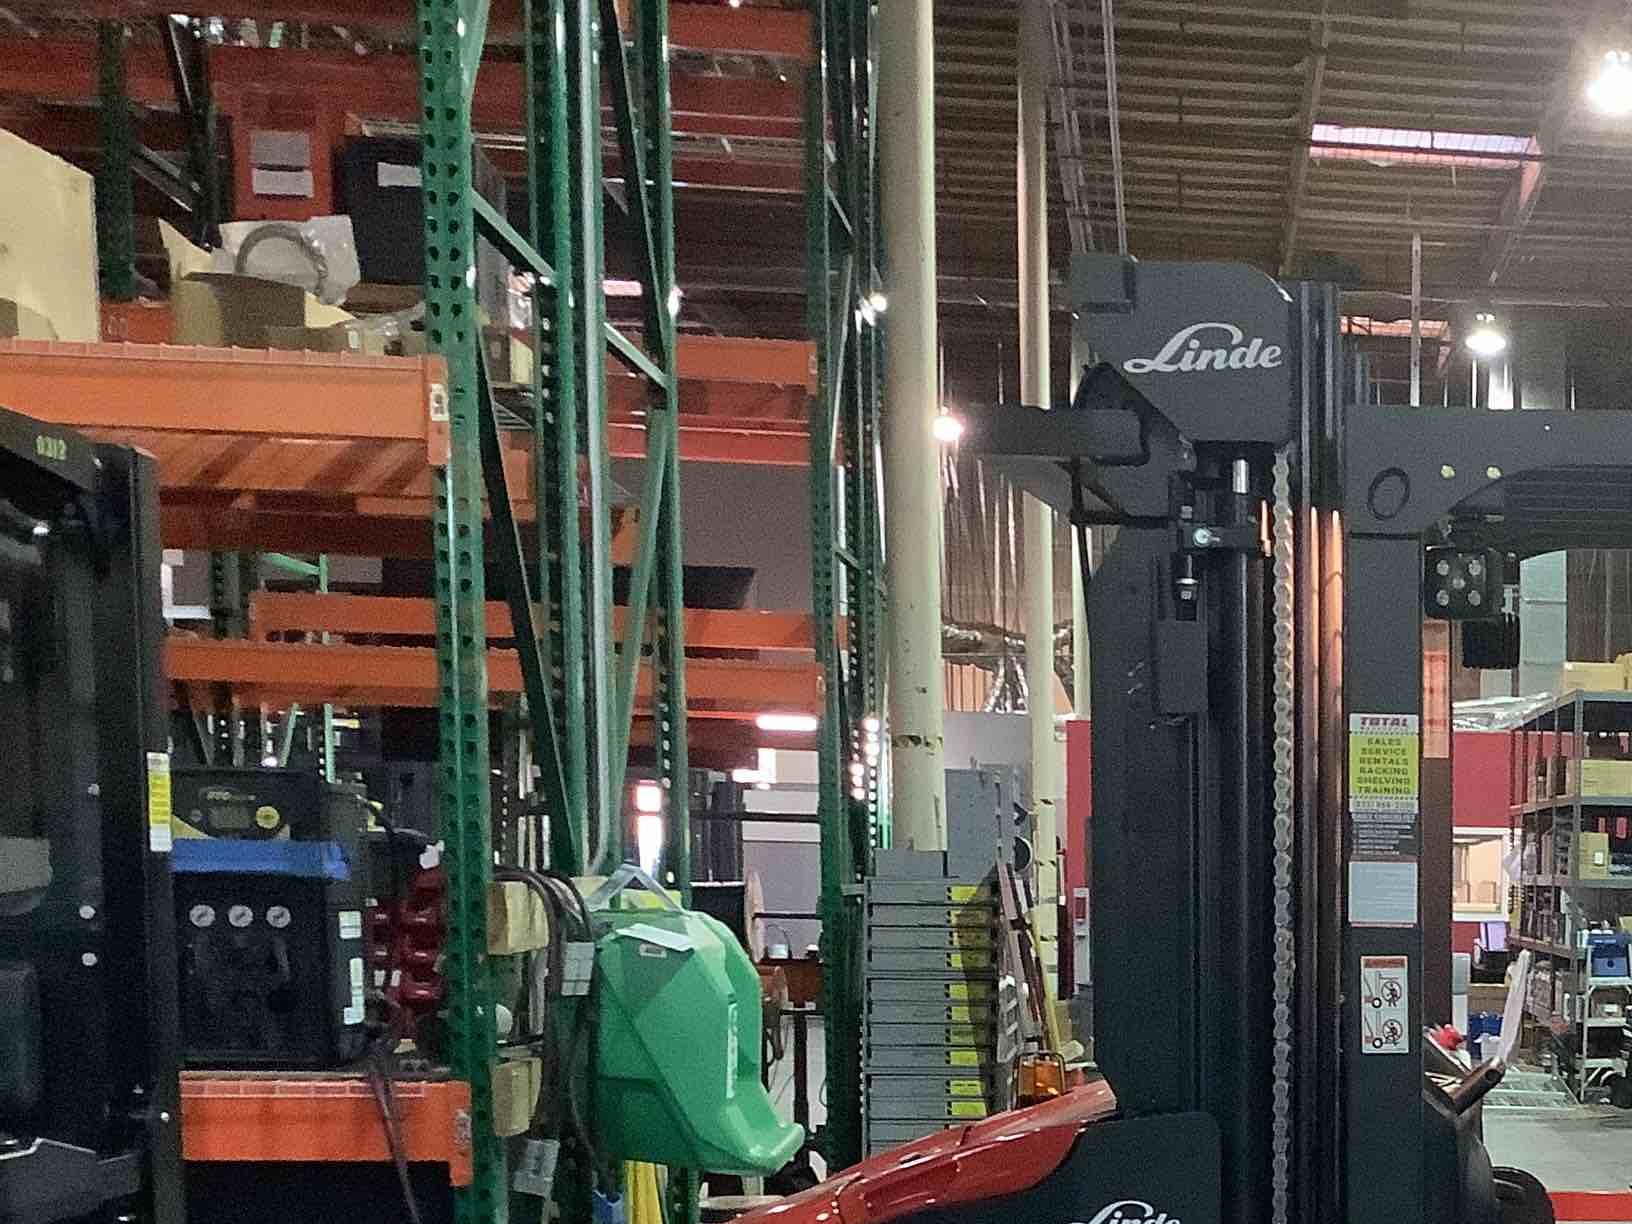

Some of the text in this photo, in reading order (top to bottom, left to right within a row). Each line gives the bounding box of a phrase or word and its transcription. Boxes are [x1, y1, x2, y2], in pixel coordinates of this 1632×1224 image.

[1123, 322, 1283, 374] Linde
[1361, 717, 1408, 727] TOTAL
[1367, 737, 1402, 746] SALES
[1361, 747, 1408, 756] SERVICE
[1360, 758, 1409, 766] RENTALS
[1360, 767, 1409, 775] RACKING
[1357, 776, 1411, 785] SHELVING
[1358, 786, 1412, 795] TRAINING
